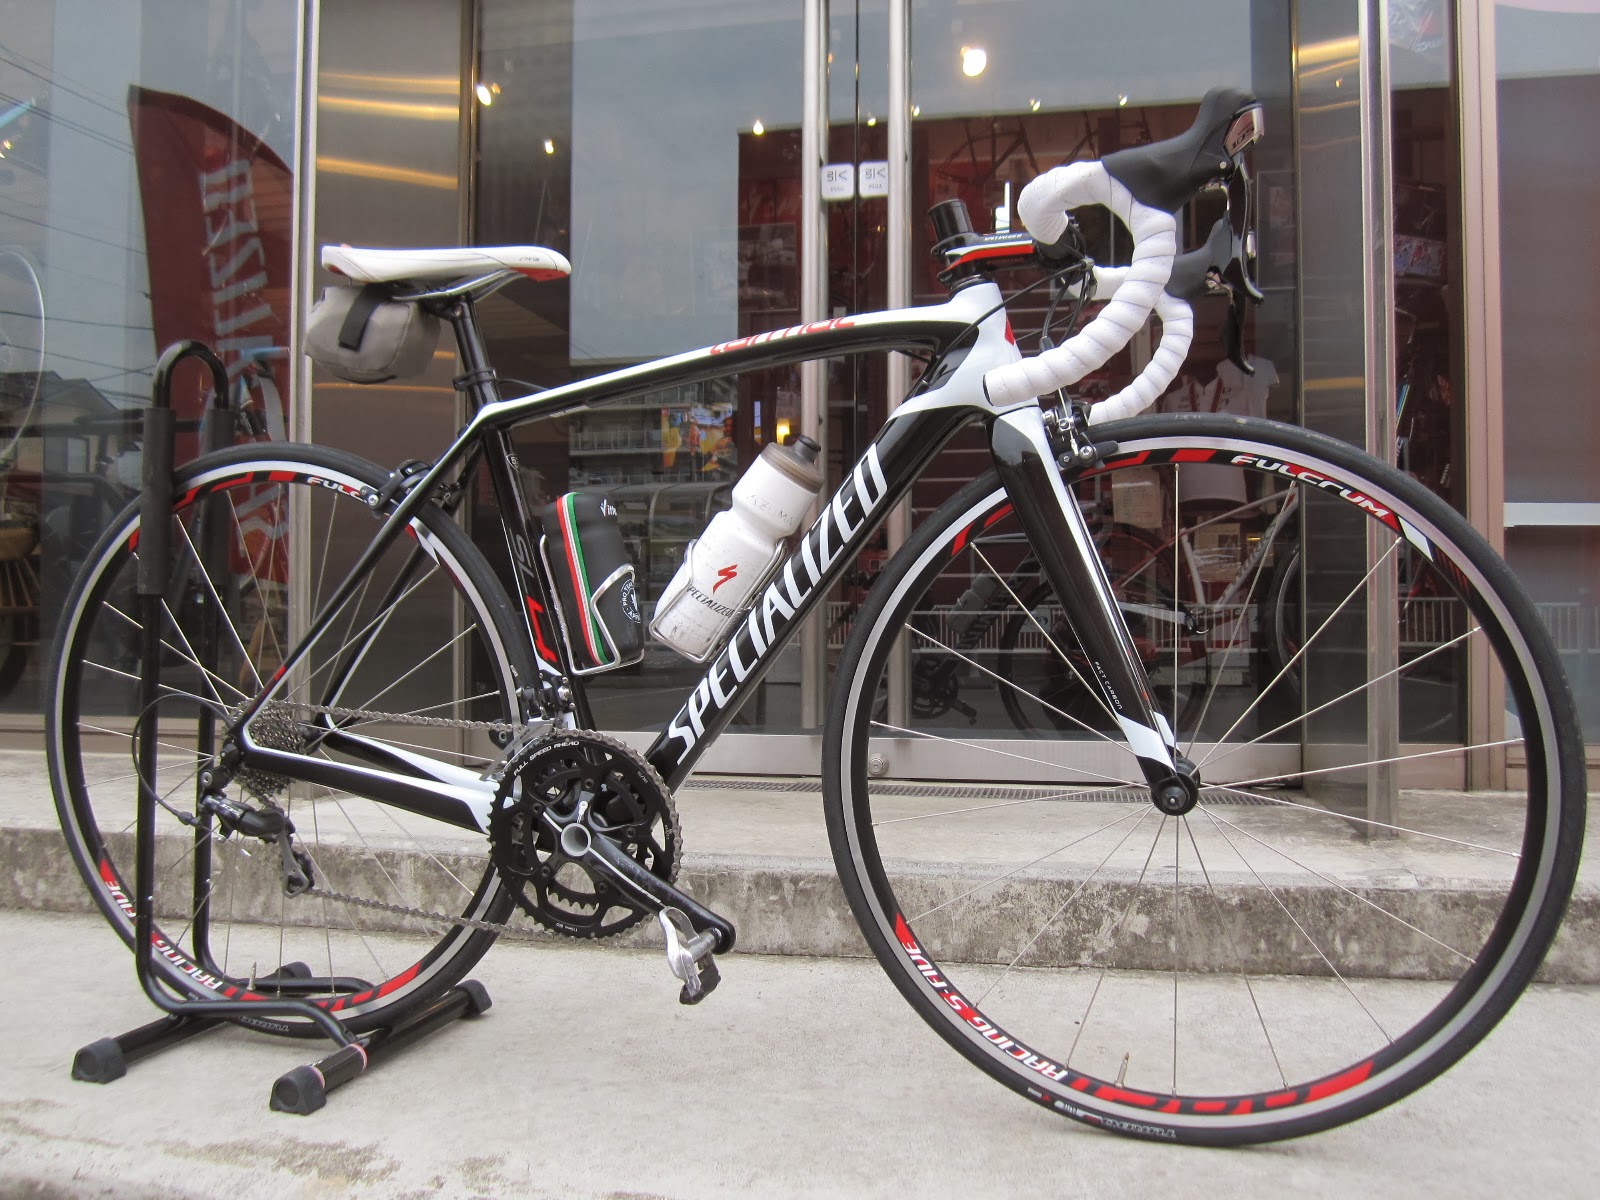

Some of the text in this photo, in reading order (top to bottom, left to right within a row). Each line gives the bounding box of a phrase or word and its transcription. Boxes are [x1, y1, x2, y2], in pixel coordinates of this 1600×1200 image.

[306, 476, 368, 504] FULC
[1230, 454, 1389, 518] FULCRUM
[669, 443, 888, 765] SPECIALIZED
[1094, 661, 1123, 710] FACT CARBON
[513, 740, 580, 776] FULL SPEED AHEAD
[153, 939, 224, 990] RACING
[966, 1016, 1069, 1081] RACING
